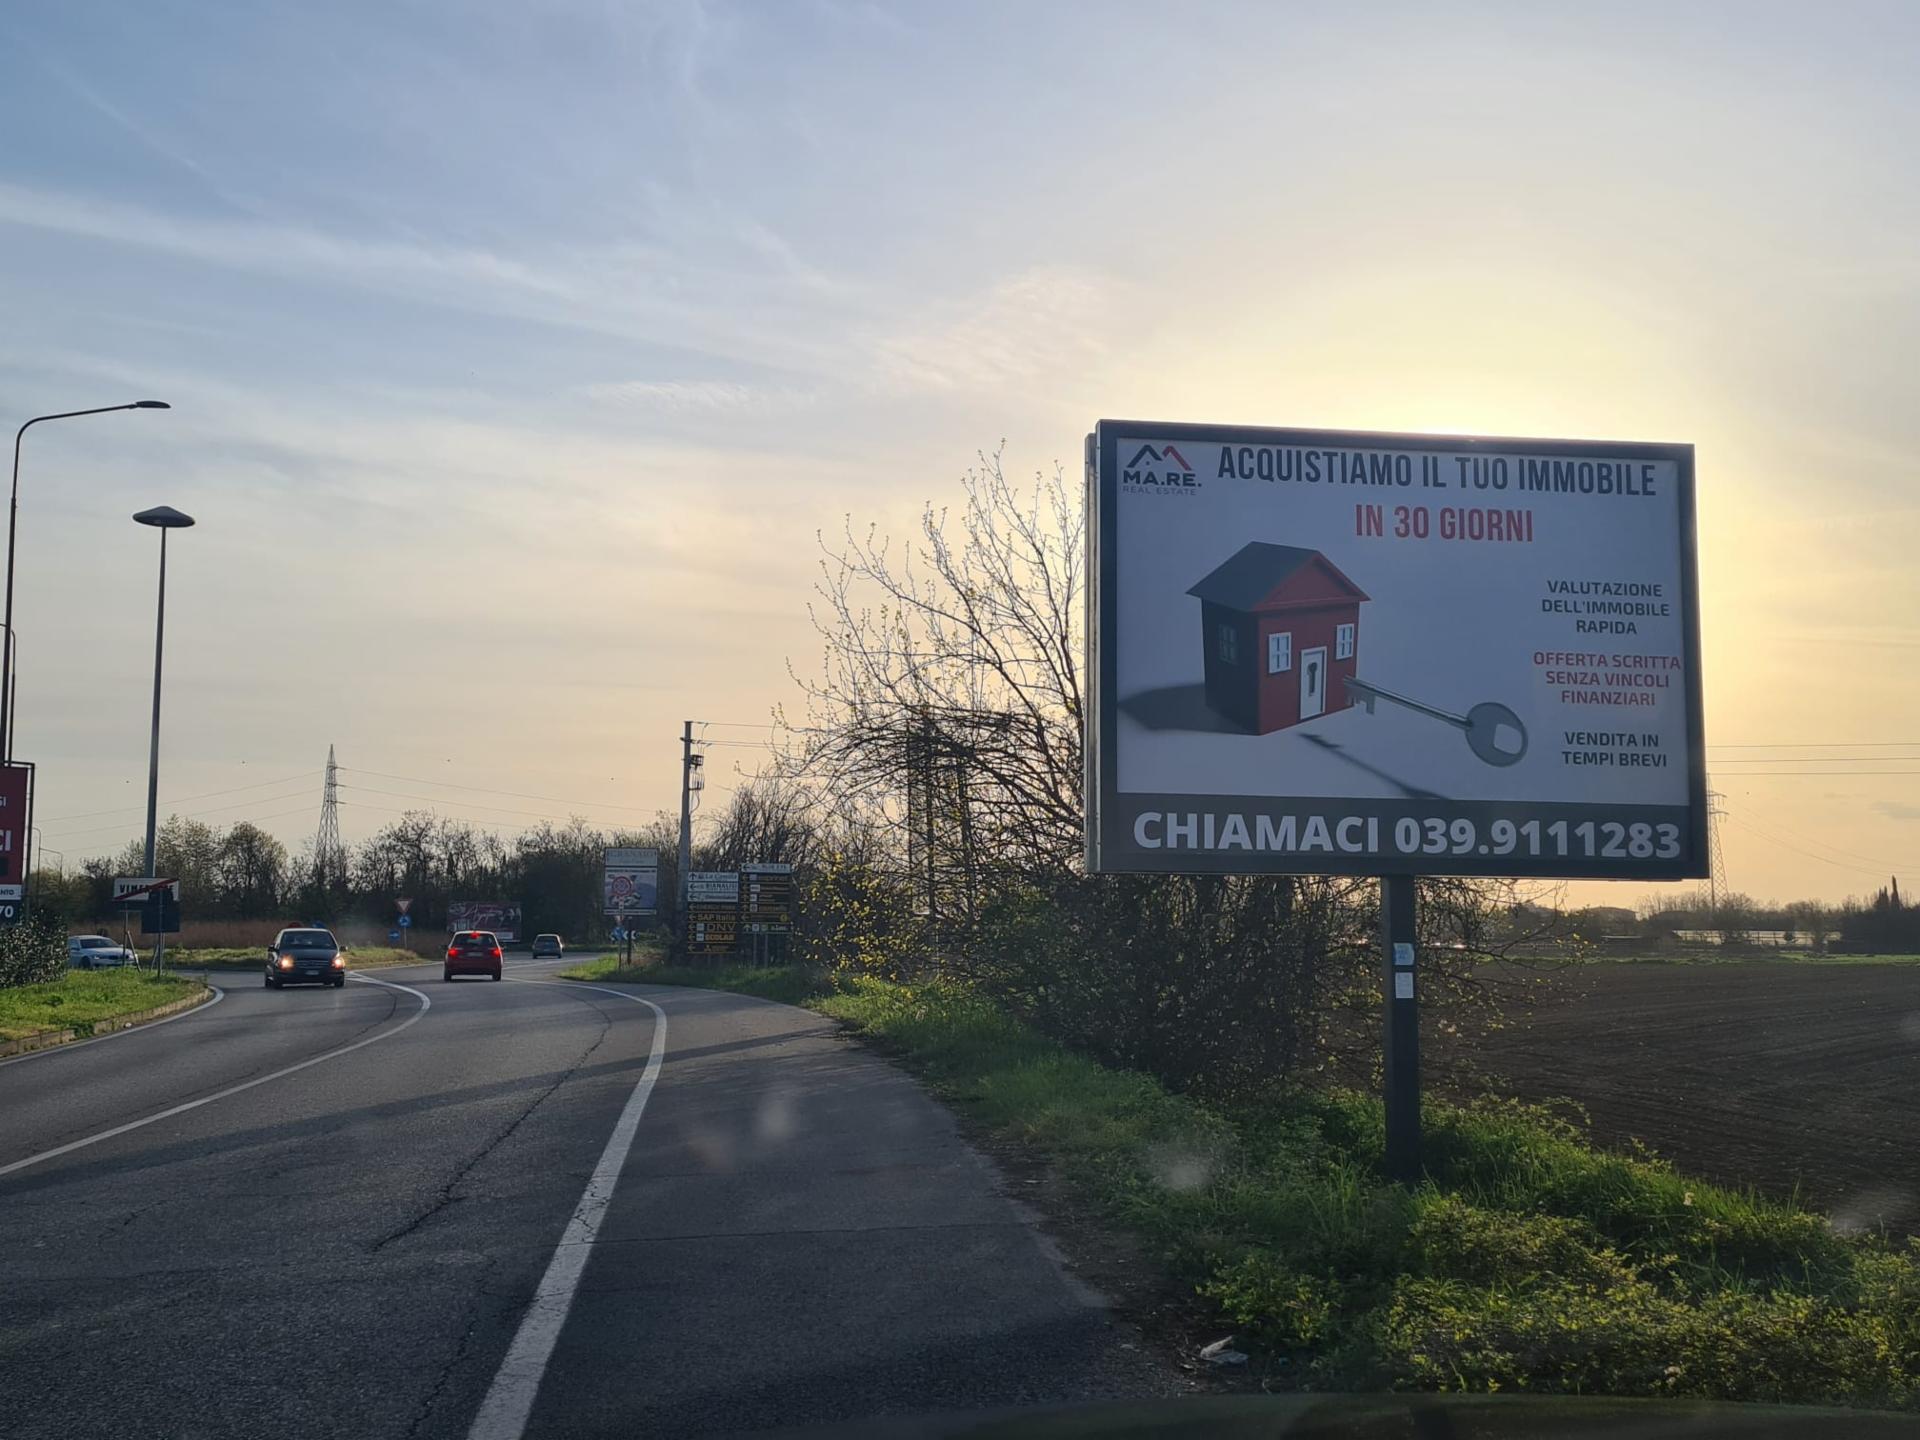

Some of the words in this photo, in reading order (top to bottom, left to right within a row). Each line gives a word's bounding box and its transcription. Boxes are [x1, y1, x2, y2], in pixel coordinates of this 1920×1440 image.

[1123, 470, 1202, 487] MA.RE.
[1218, 446, 1412, 487] ACQUISTIAMO
[1423, 455, 1447, 487] IL
[1455, 456, 1508, 489] TUO
[1519, 458, 1656, 496] IMMOBILE
[1122, 486, 1152, 495] REAL
[1156, 488, 1197, 496] ESTATE
[1356, 504, 1383, 537] IN
[1394, 505, 1430, 539] 30
[1440, 507, 1533, 542] GIORNI
[1547, 580, 1662, 597] VALUTAZIONE
[1542, 599, 1670, 616] DELL'IMMOBILE
[1576, 620, 1637, 634] RAPIDA
[1533, 652, 1608, 667] OFFERTA
[1612, 655, 1681, 669] SCRITTA
[1546, 671, 1600, 685] SENZA
[1605, 673, 1669, 688] VINCOLI
[1561, 690, 1655, 706] FINANZIARI
[1565, 732, 1637, 746] VENDITA
[1642, 734, 1659, 747] IN
[1562, 751, 1613, 766] TEMPI
[1618, 753, 1667, 767] BREVI
[1133, 812, 1379, 853] CHIAMACI
[1394, 817, 1681, 858] 039.9111283
